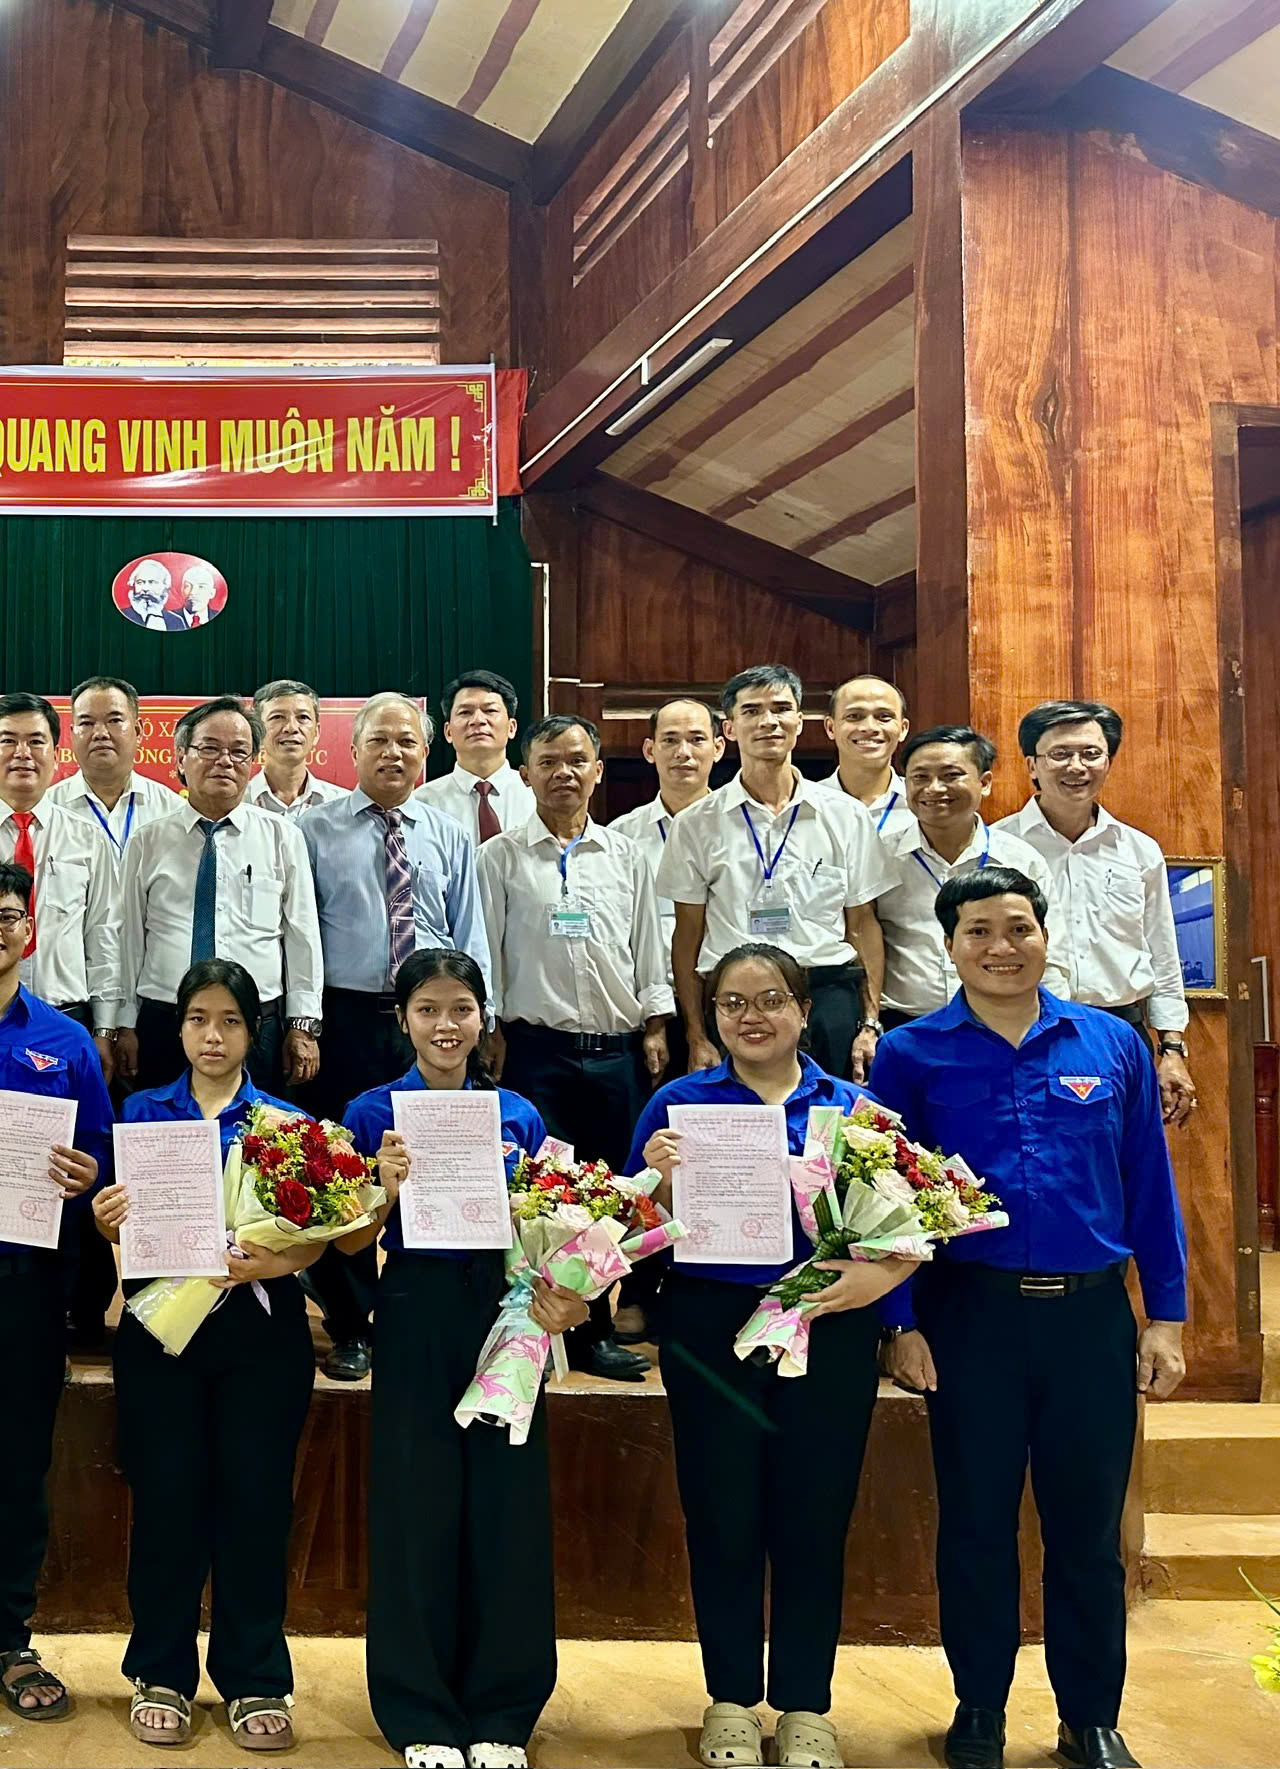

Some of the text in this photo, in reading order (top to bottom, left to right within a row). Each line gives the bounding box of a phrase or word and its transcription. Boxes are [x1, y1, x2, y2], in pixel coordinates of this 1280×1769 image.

[118, 419, 207, 473] VINH
[221, 407, 334, 473] MUÔN
[346, 405, 435, 472] NĂM
[451, 416, 460, 472] !
